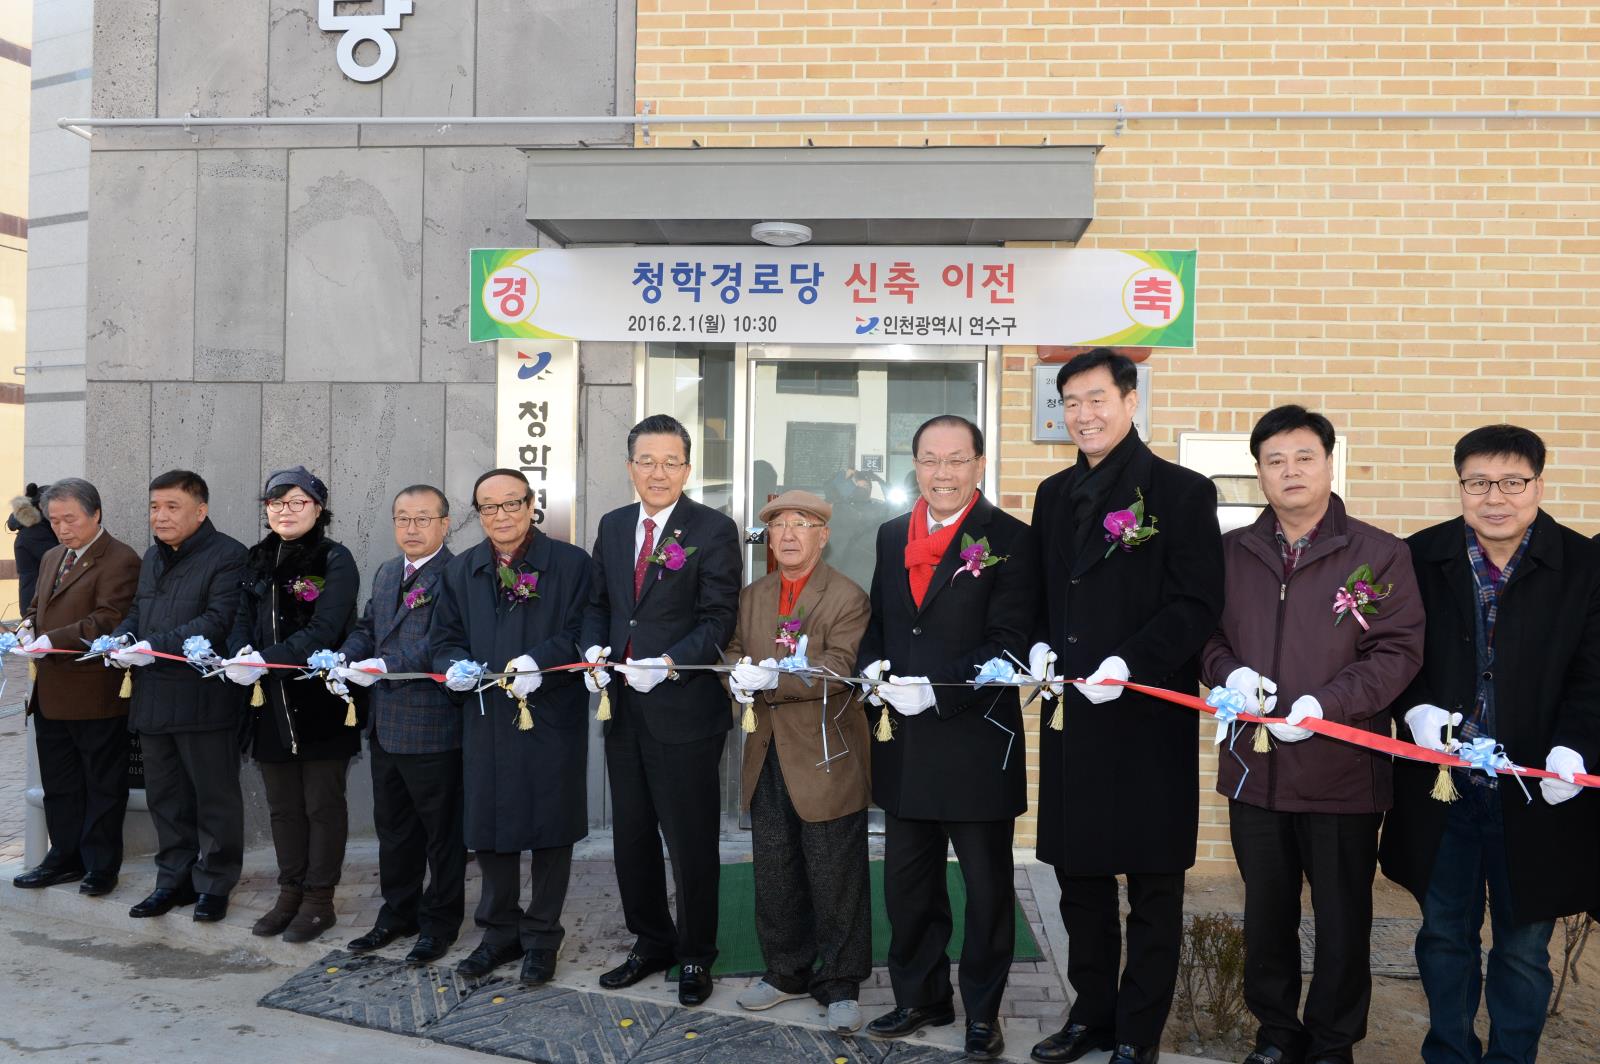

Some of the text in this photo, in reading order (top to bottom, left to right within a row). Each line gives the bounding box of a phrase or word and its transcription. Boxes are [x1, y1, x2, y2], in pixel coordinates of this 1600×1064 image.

[318, 0, 413, 83] 당
[492, 277, 527, 317] 경
[631, 261, 1015, 305] 청학경로당 신축 이전
[1133, 276, 1172, 320] 축
[628, 314, 777, 333] 2016.2.1(월) 10:30
[883, 315, 1017, 337] 인천광역시 연수구
